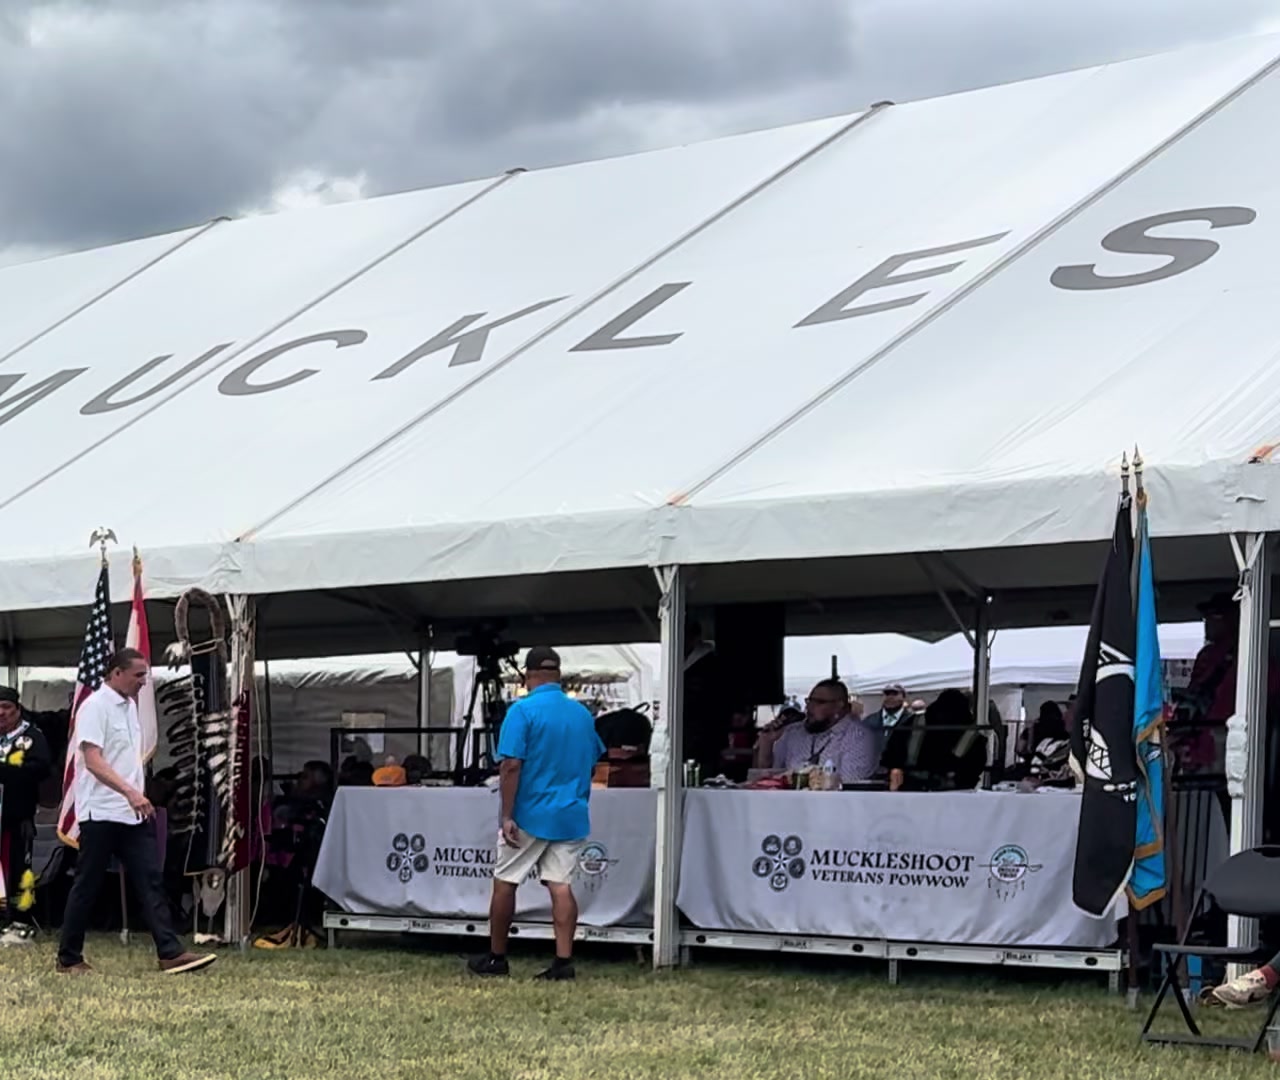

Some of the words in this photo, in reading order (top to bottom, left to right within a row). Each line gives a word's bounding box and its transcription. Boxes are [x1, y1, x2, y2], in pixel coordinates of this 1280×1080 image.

[433, 847, 497, 864] MUCKL
[810, 849, 975, 872] MUCKLESHOOT
[434, 865, 495, 879] VETERANS
[811, 868, 885, 885] VETERANS
[889, 873, 970, 888] POWWOW
